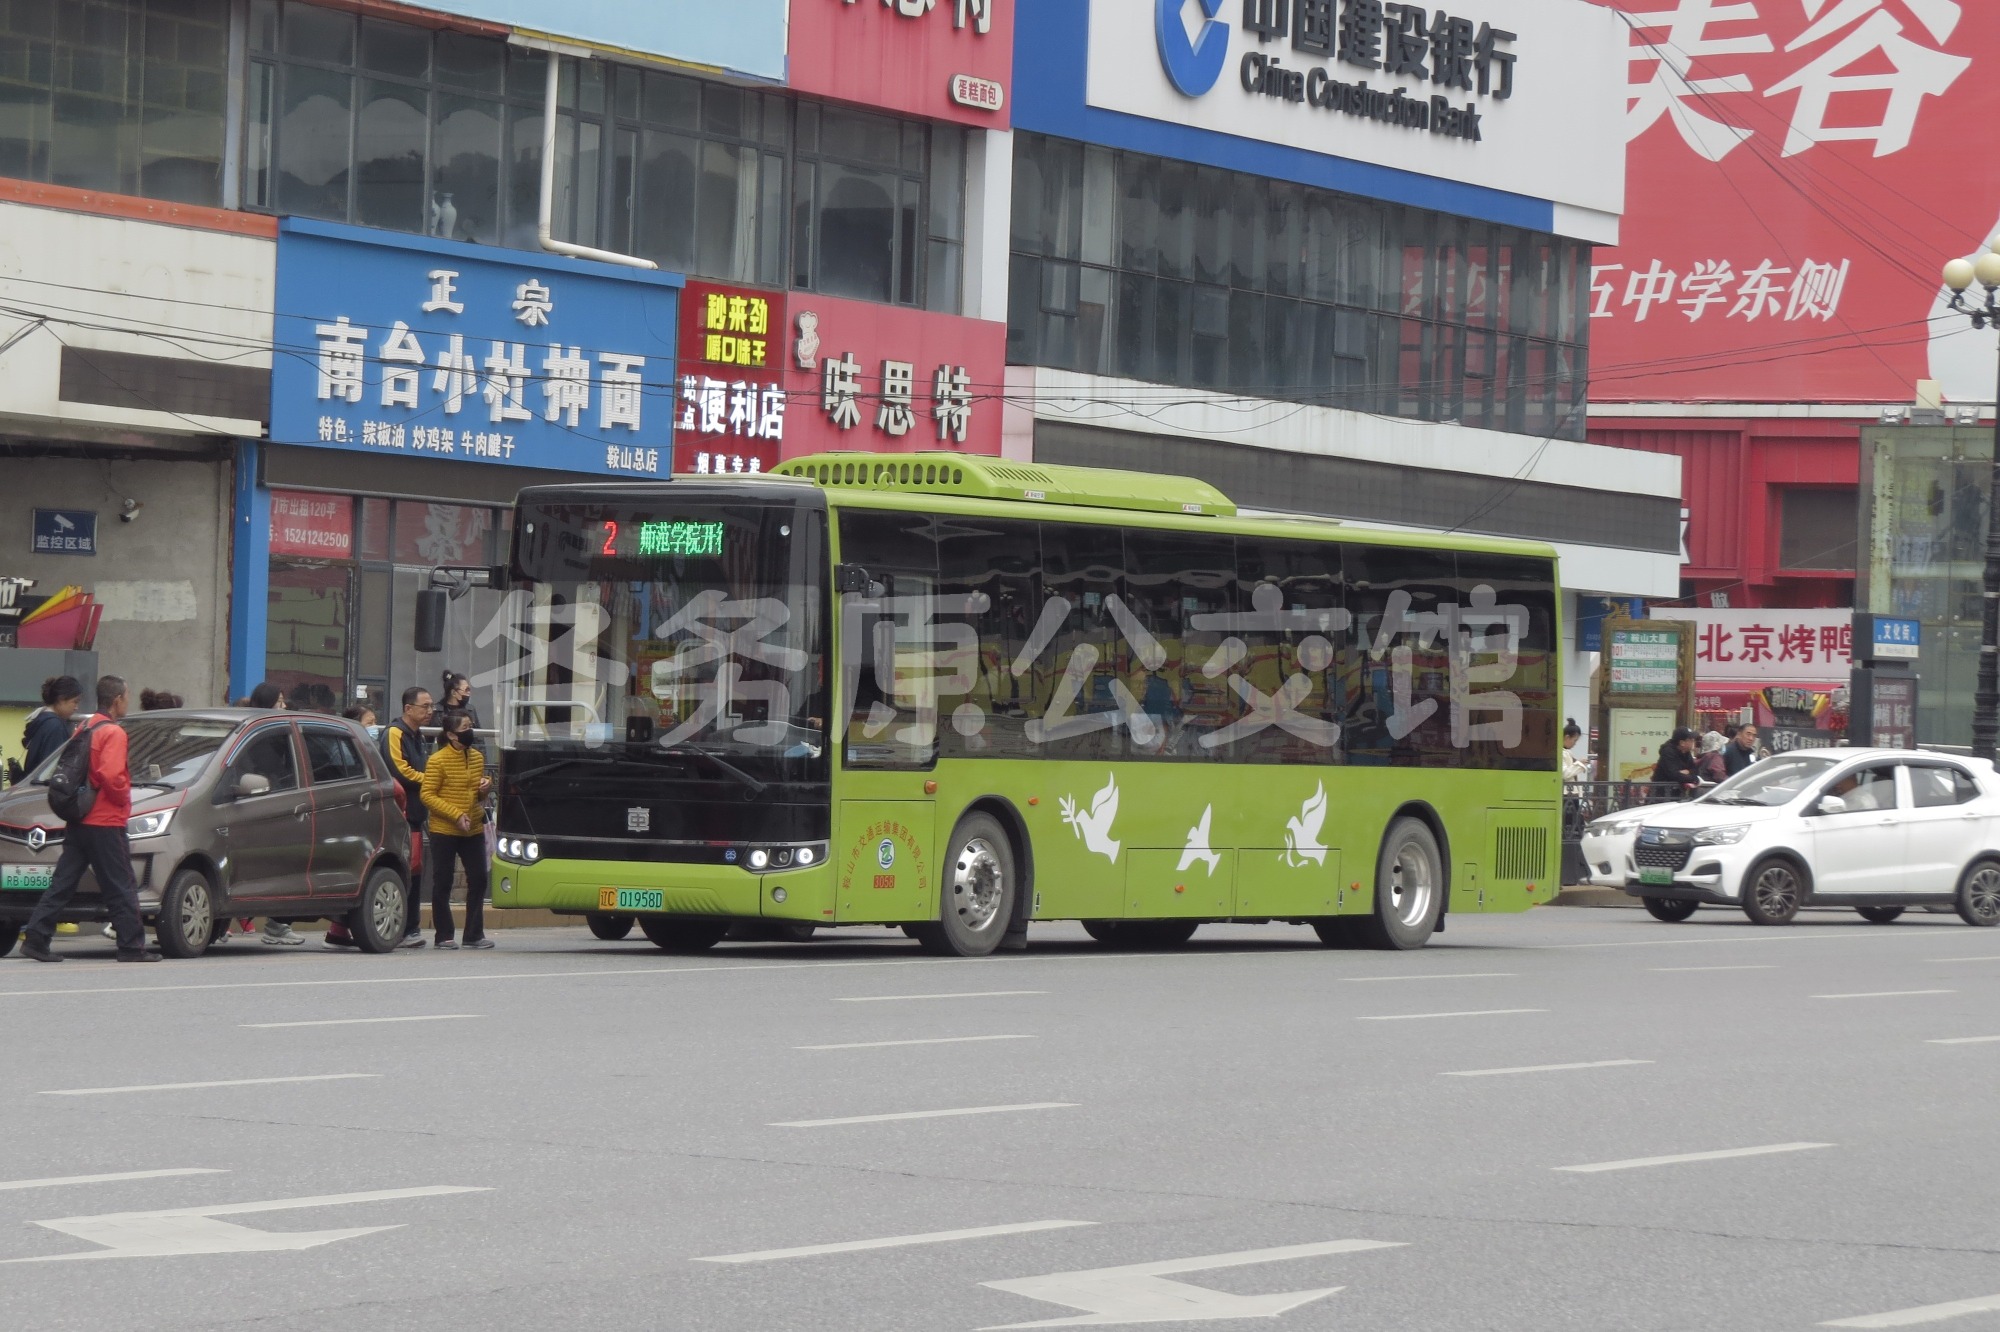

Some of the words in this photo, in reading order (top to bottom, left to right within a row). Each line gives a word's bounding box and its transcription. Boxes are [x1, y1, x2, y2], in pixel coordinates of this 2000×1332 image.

[1243, 0, 1517, 101] 中国建设银行
[958, 79, 997, 105] 蛋糕面包
[1240, 51, 1305, 103] China
[1306, 66, 1429, 130] Construction
[1430, 94, 1482, 141] Bank
[421, 269, 553, 327] 正宗
[699, 376, 786, 440] 便利店
[823, 351, 973, 442] 味思特
[362, 419, 405, 449] 辣椒油
[412, 425, 454, 453] 炒鸡架
[606, 445, 659, 473] 鞍山总店
[36, 534, 92, 551] 监控区域
[284, 527, 349, 549] 15241242500
[604, 521, 617, 555] 2
[1697, 623, 1853, 664] 北京烤鸭
[874, 875, 895, 888] 3058
